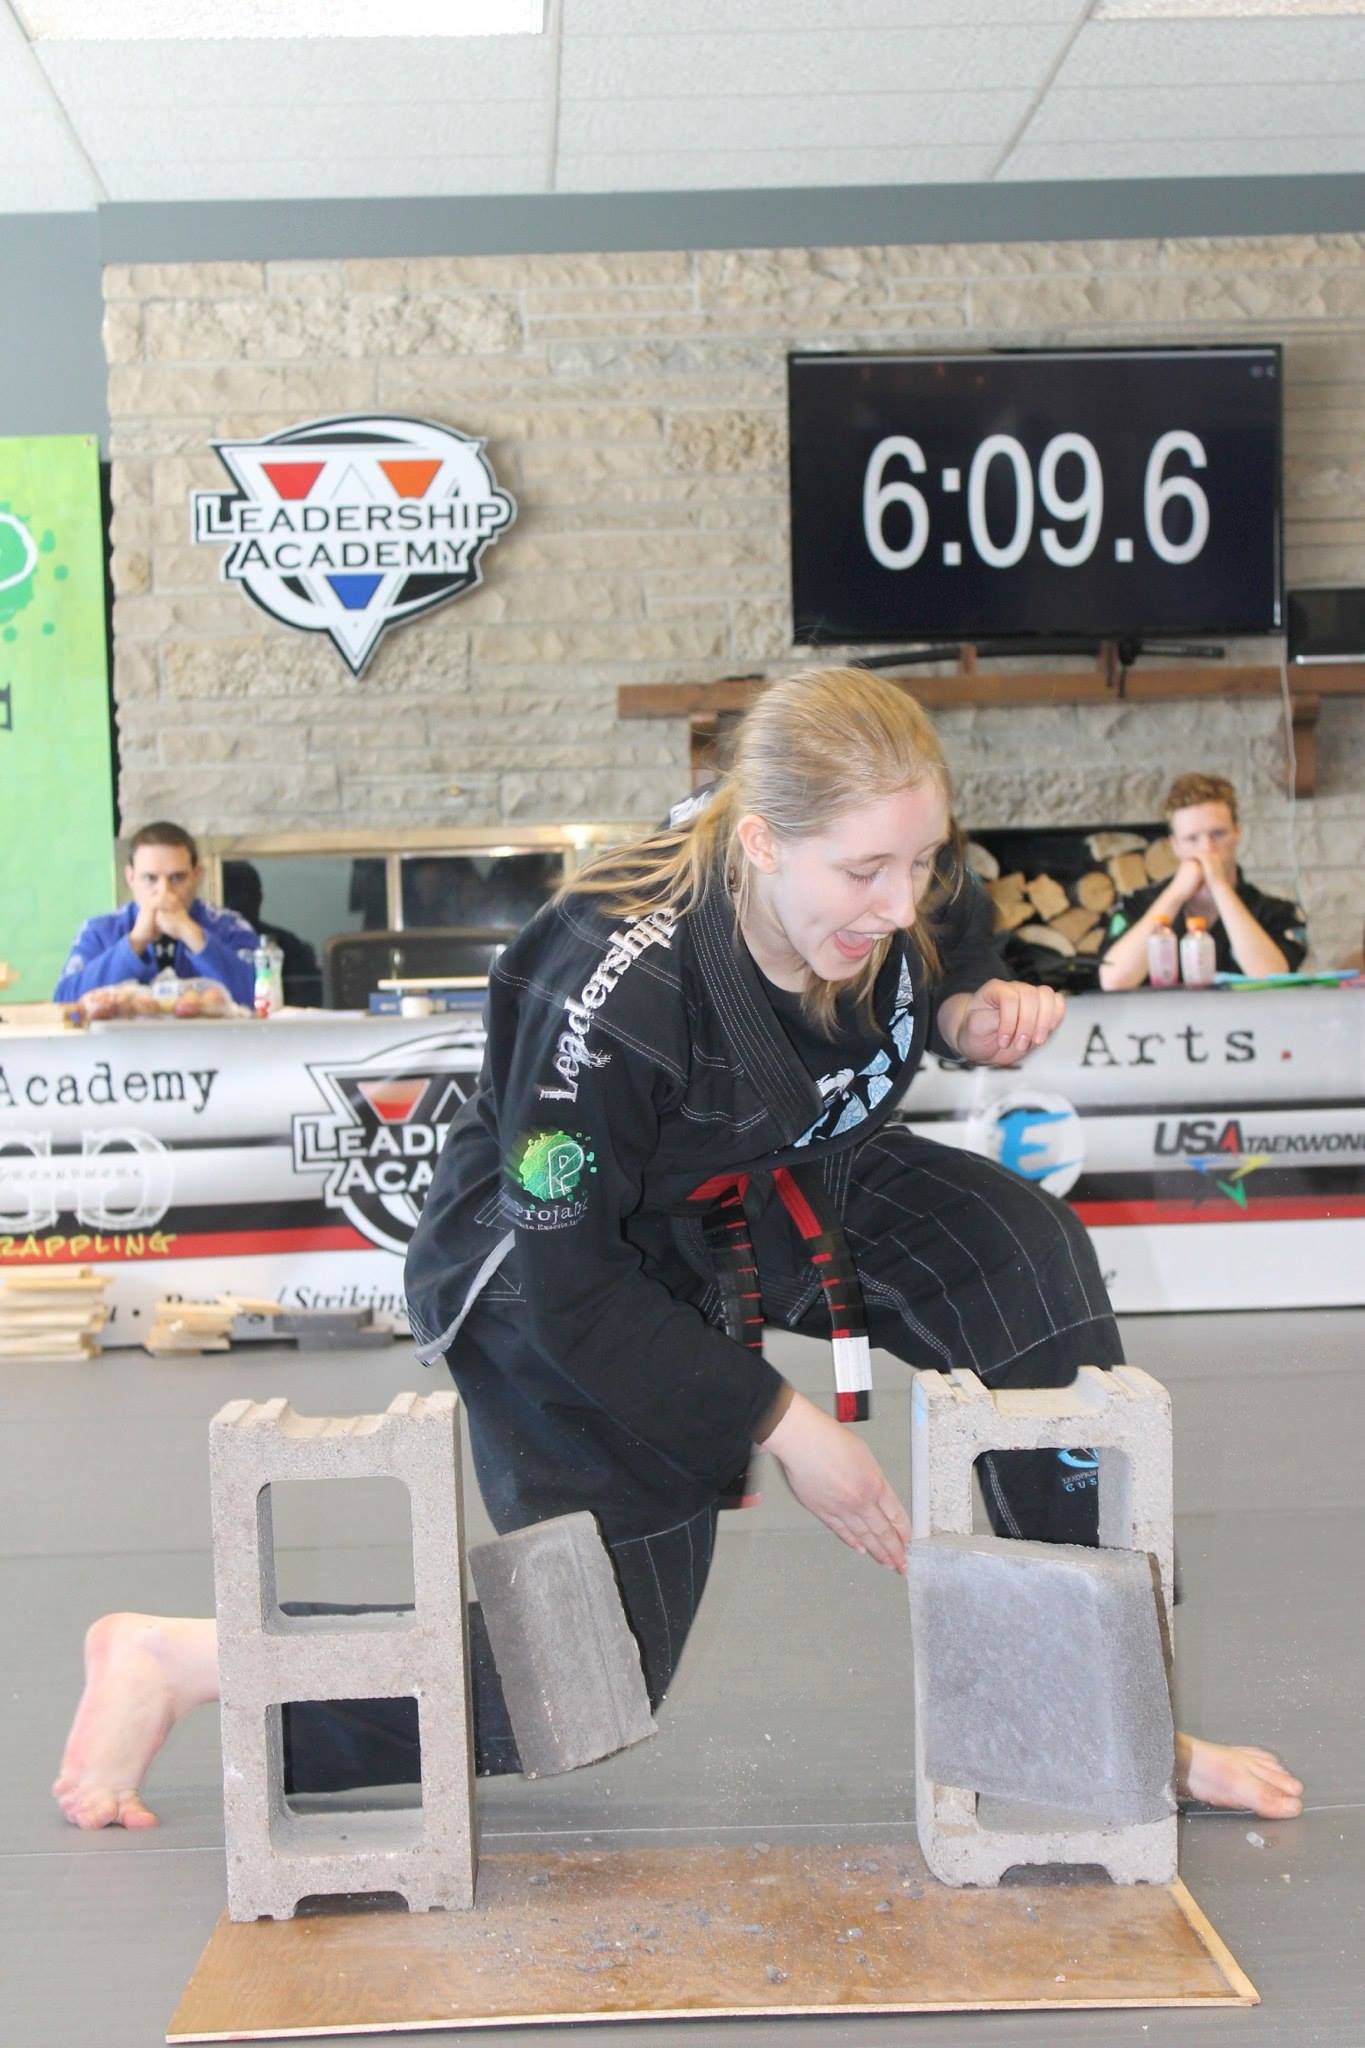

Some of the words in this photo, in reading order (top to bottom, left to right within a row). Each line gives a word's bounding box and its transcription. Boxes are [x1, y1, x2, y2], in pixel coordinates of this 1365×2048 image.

[863, 429, 1210, 571] 6:09.6
[207, 502, 503, 534] LEADERSHIP
[238, 539, 469, 570] ACADEMY
[1153, 1118, 1245, 1157] USA
